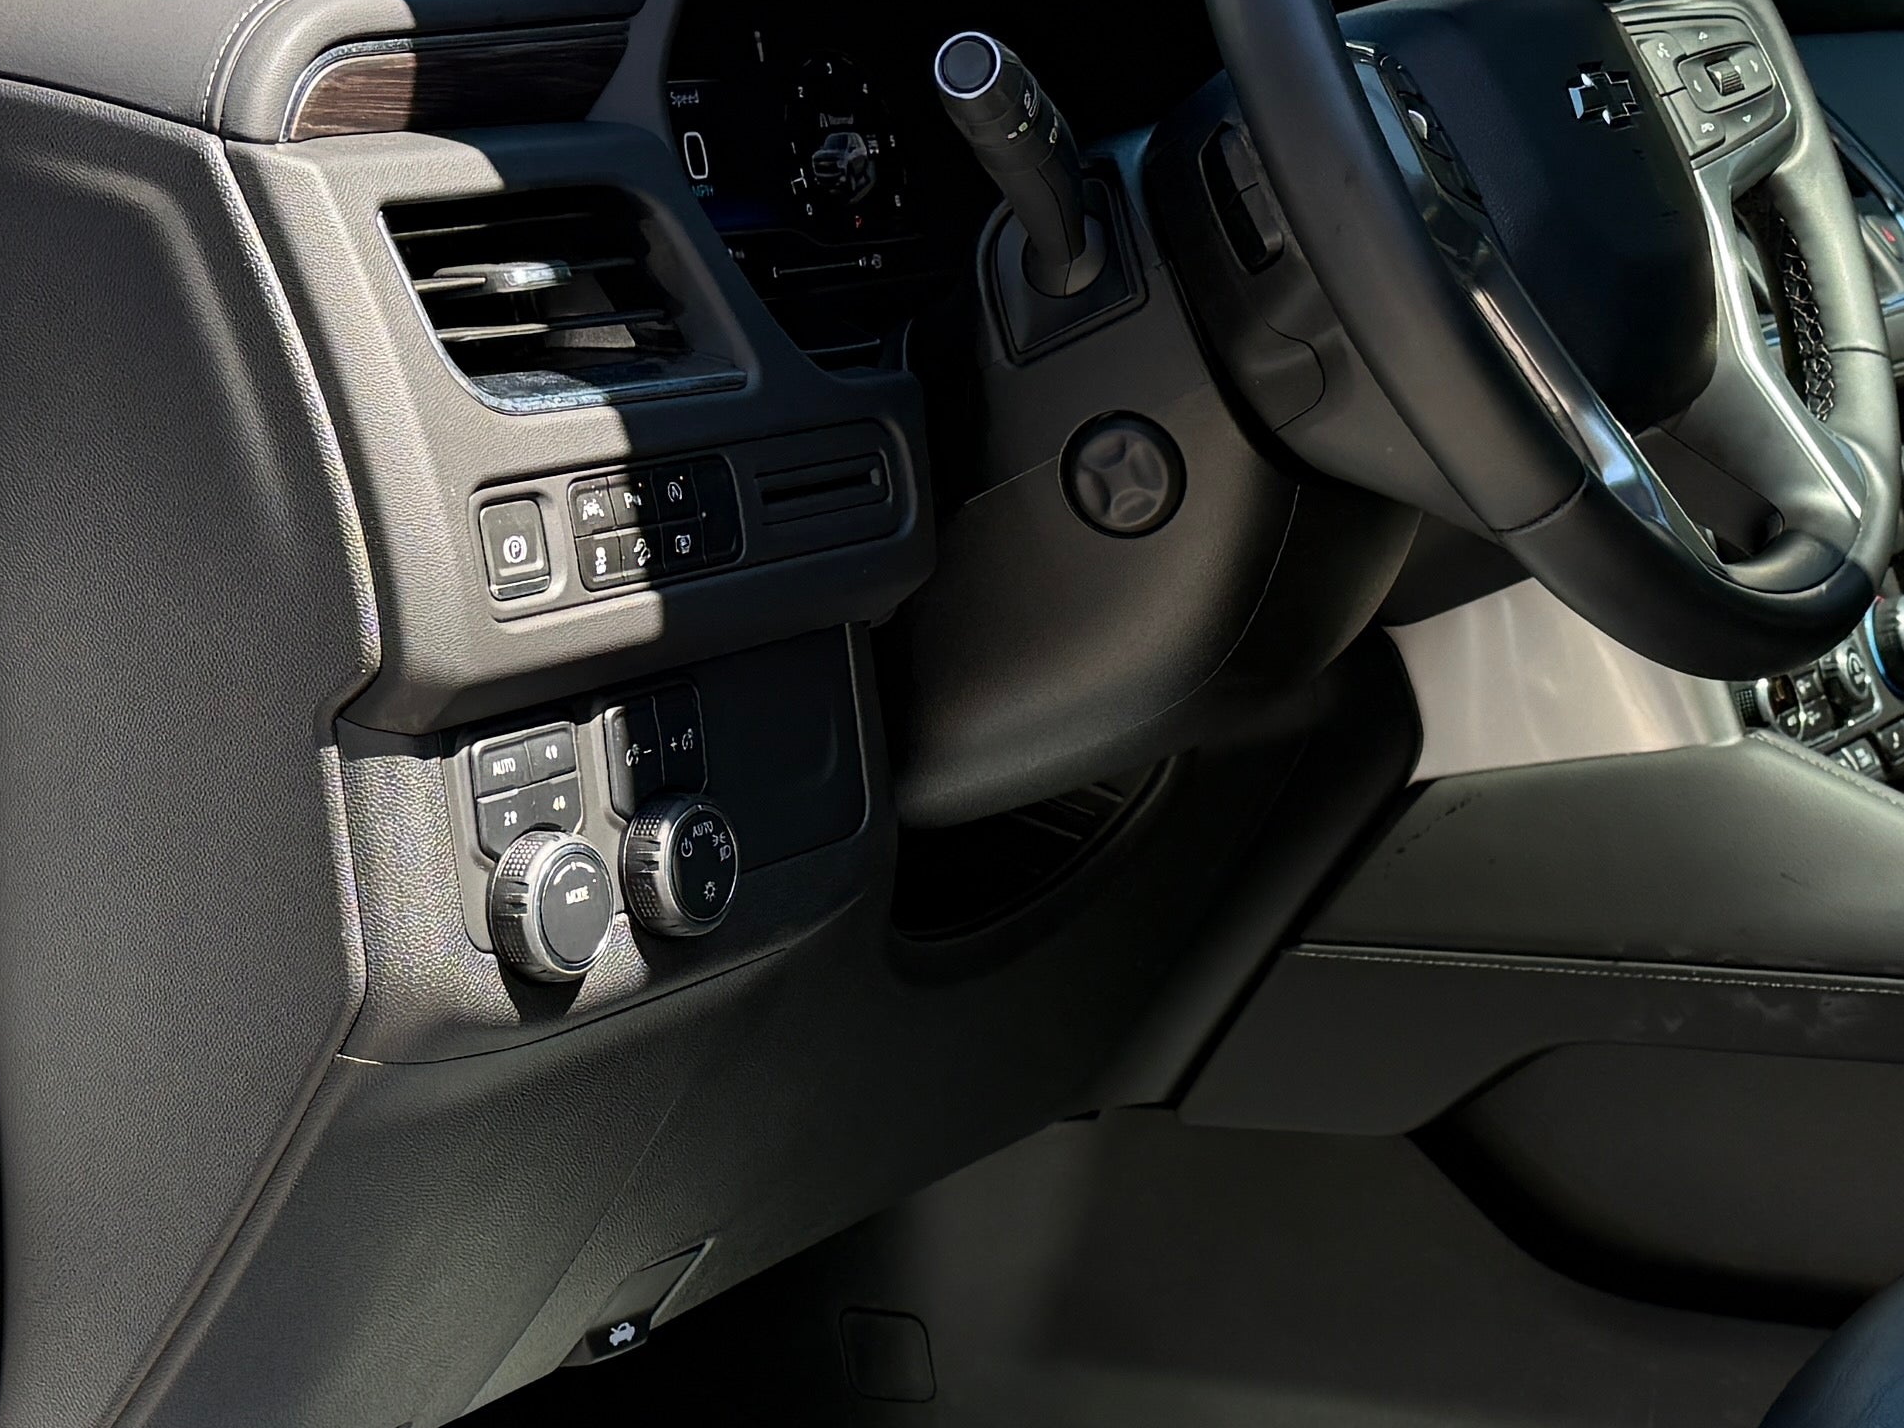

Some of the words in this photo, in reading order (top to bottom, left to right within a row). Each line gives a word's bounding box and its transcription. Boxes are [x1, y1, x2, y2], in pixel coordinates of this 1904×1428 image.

[670, 88, 700, 108] Speed
[684, 132, 708, 179] 0
[492, 757, 516, 776] AUTO
[692, 820, 714, 839] AUTO
[565, 885, 590, 905] MODE
